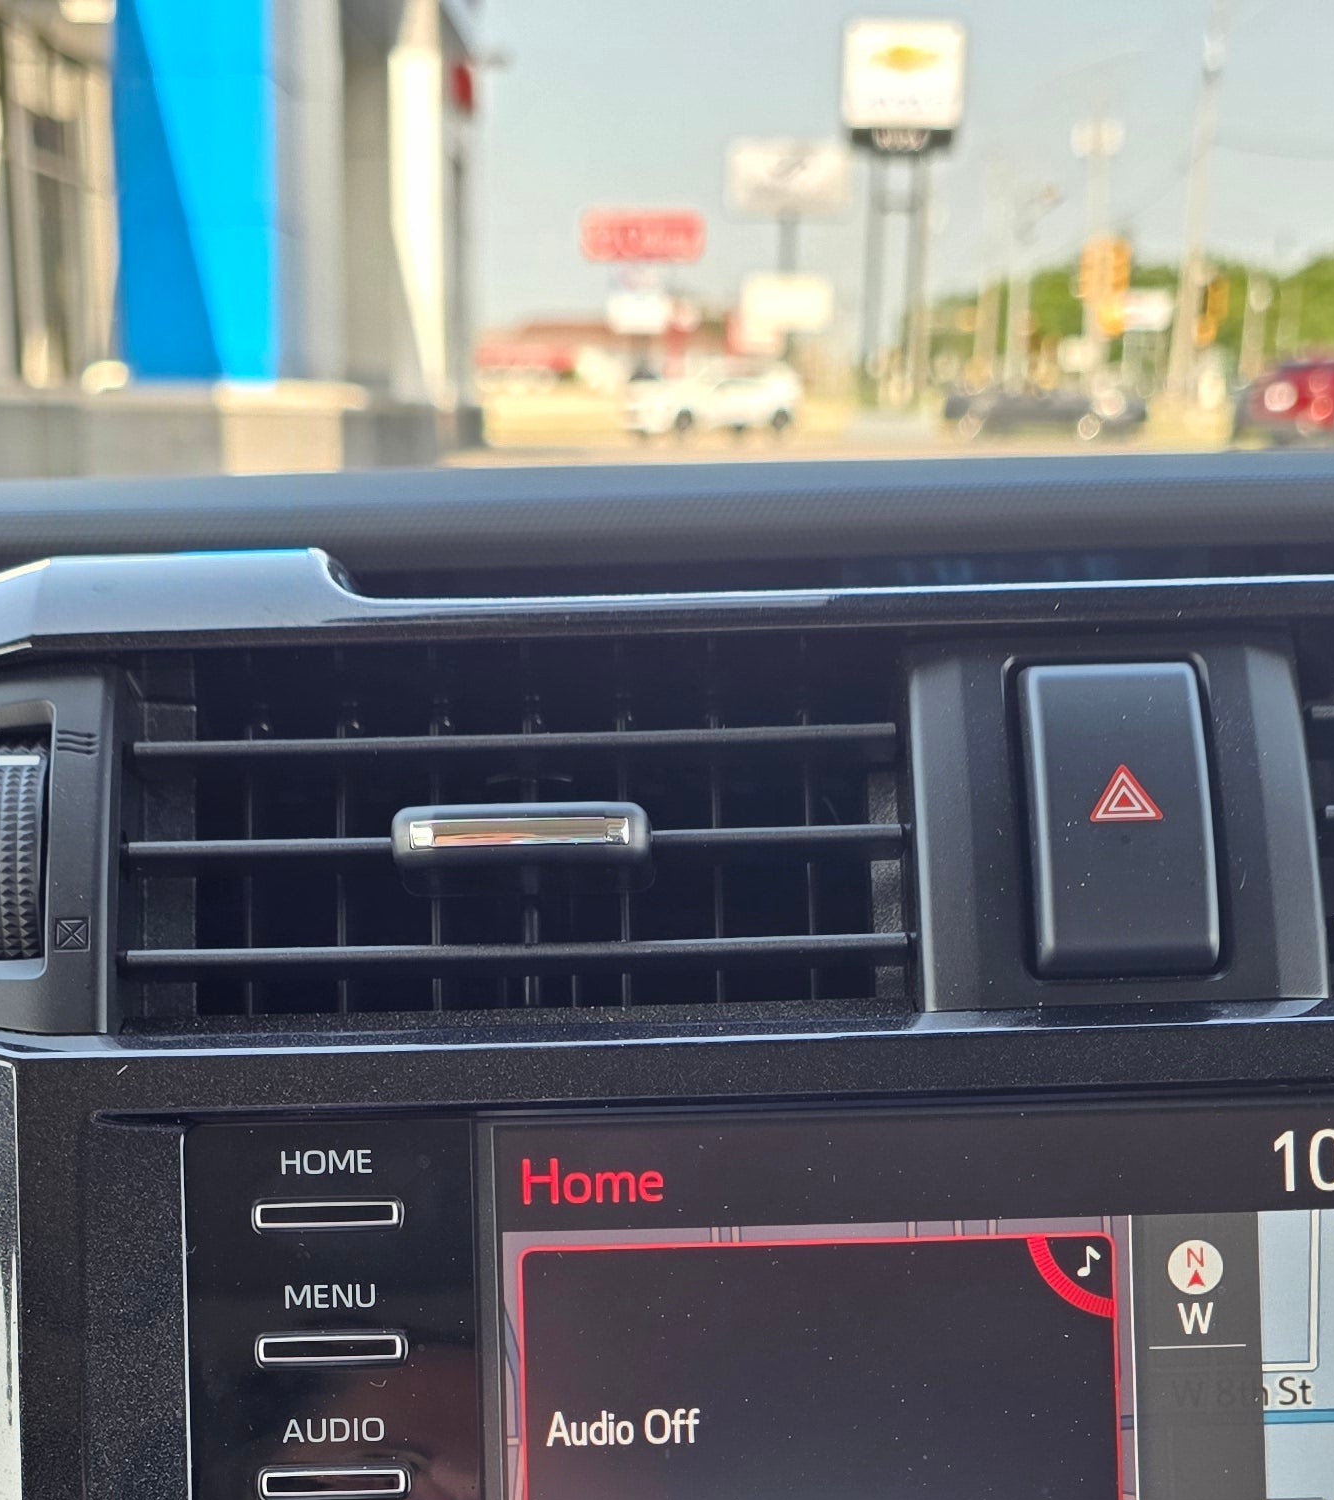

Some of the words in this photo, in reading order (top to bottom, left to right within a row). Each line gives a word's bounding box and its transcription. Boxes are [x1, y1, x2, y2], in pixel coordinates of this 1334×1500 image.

[281, 1150, 372, 1174] HOME
[522, 1158, 663, 1204] Home
[285, 1284, 375, 1309] MENU
[1178, 1302, 1213, 1334] W
[1279, 1377, 1311, 1405] St
[283, 1418, 384, 1443] AUDIO
[546, 1410, 634, 1446] Audio
[645, 1408, 700, 1444] Off
